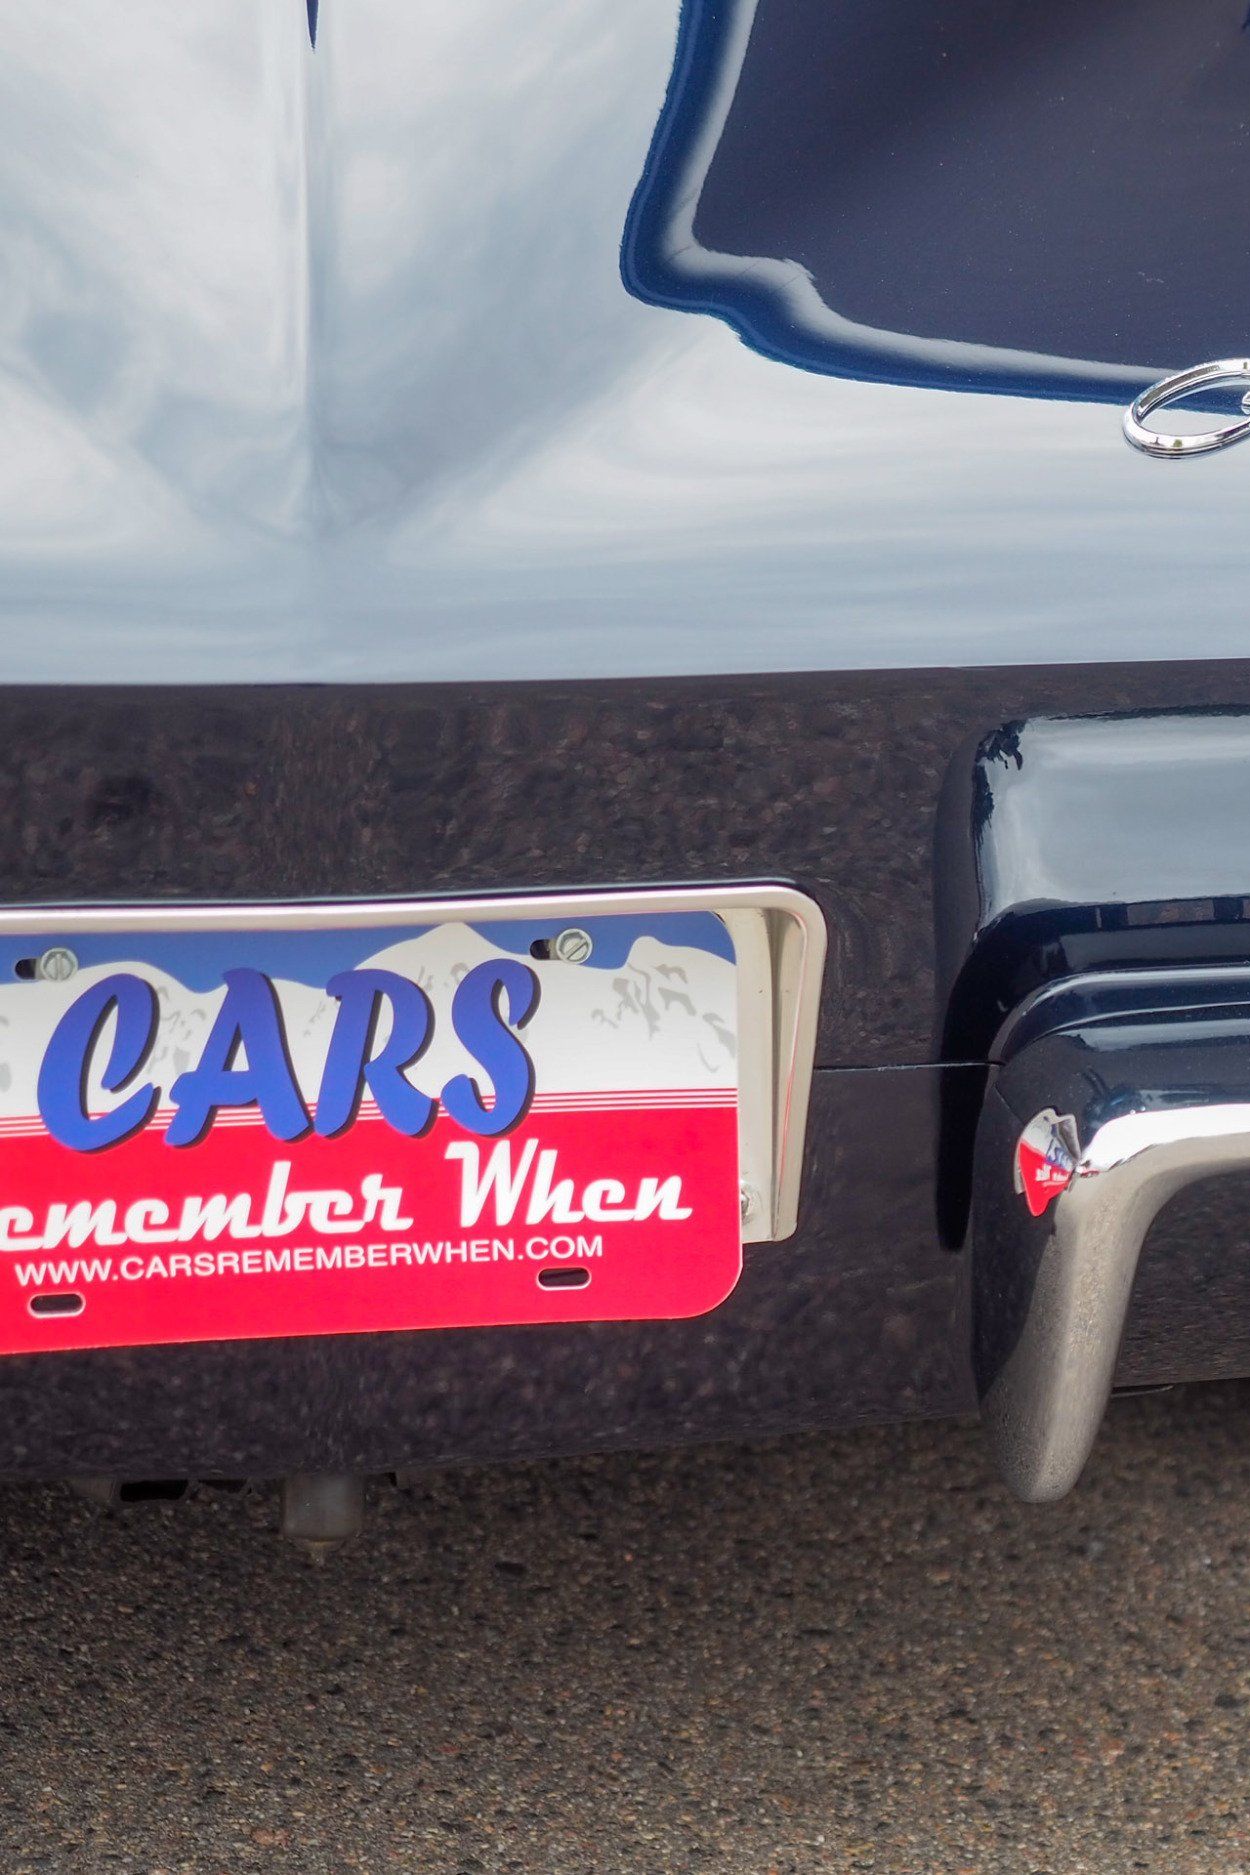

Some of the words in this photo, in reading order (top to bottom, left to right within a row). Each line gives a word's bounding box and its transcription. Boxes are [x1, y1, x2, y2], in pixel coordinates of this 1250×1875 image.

[37, 957, 542, 1154] CARS
[0, 1161, 414, 1252] emember
[444, 1138, 692, 1228] When
[14, 1235, 605, 1287] WWW.CARSREMEMBERWHEN.COM
